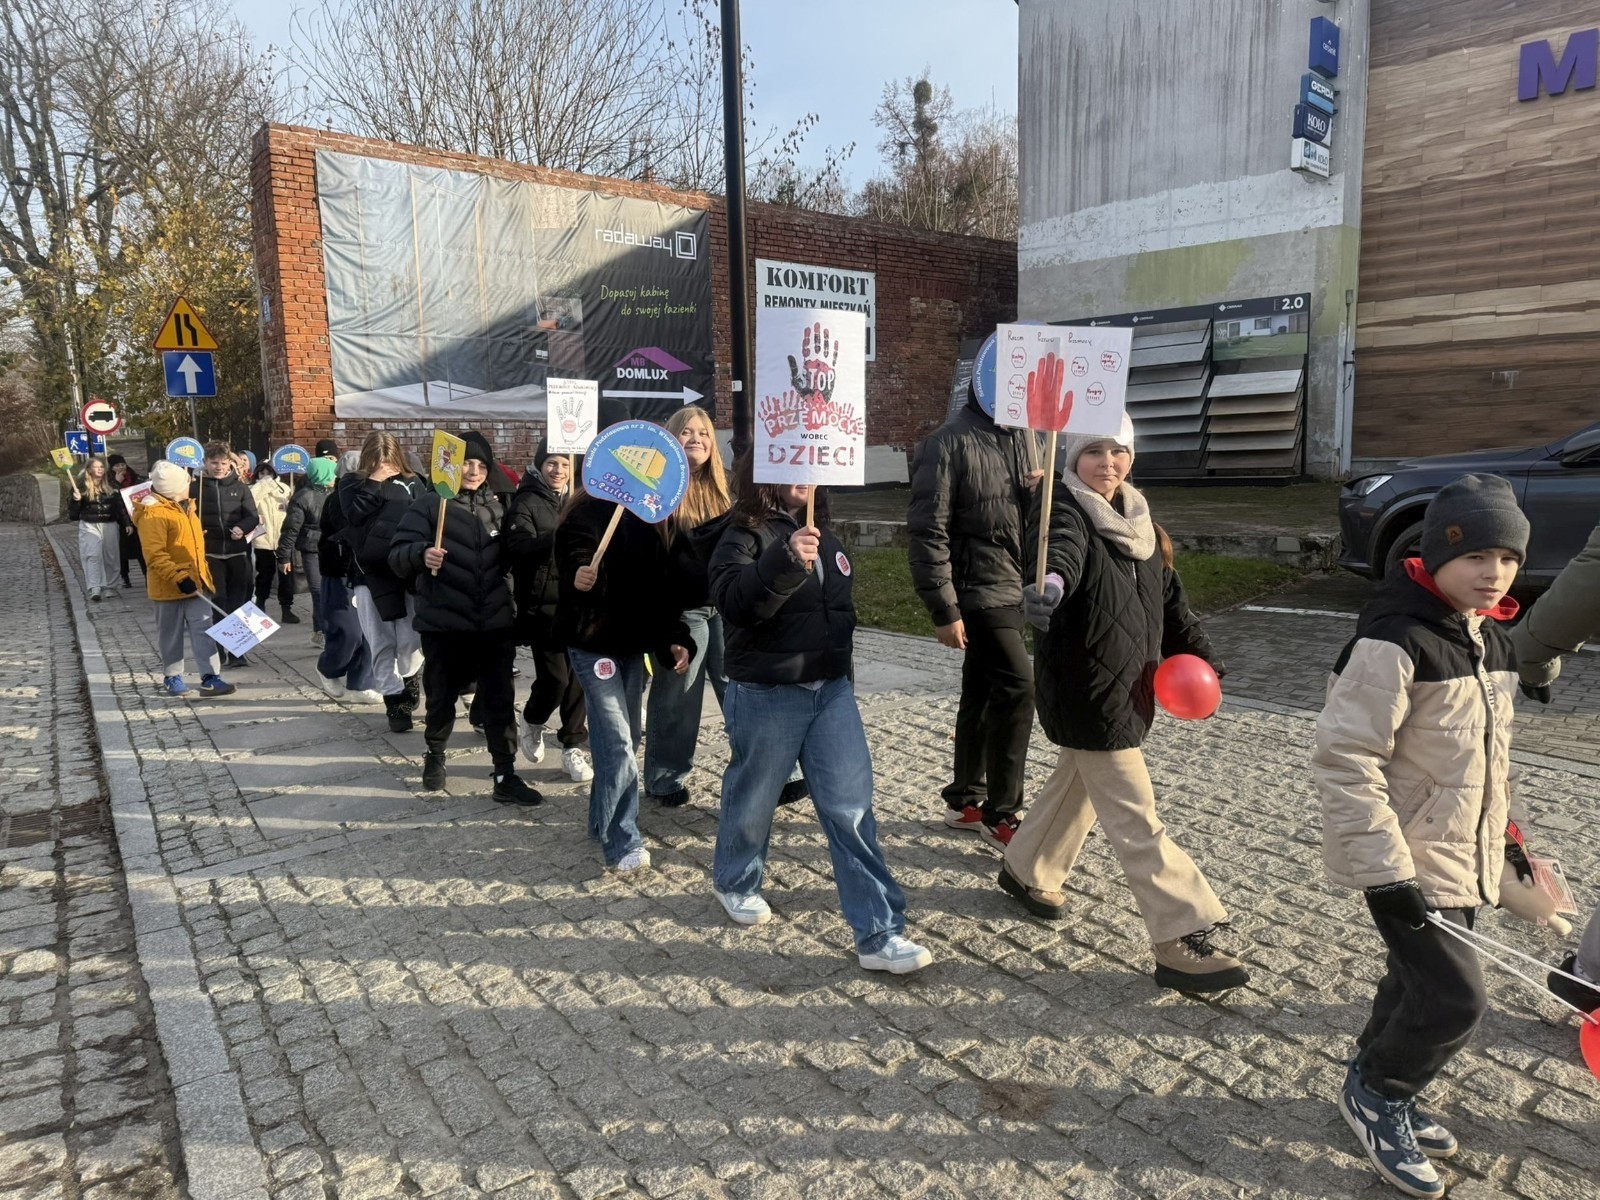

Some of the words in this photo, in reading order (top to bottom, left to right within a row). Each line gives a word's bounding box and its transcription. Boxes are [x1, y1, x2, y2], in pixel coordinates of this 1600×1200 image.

[1311, 80, 1334, 100] GERDA
[595, 223, 673, 257] radaway
[766, 266, 869, 296] KOMFORT
[600, 285, 637, 301] Dopasuj
[640, 285, 670, 300] kabinę
[620, 304, 632, 316] do
[635, 303, 661, 319] swojej
[664, 301, 697, 315] łazienki
[1281, 296, 1304, 310] 2.0
[630, 357, 646, 367] MB
[616, 367, 669, 380] DOMLUX
[796, 368, 835, 392] STOP
[595, 424, 630, 447] Podstawowa
[647, 426, 657, 434] im.
[800, 433, 828, 441] WOBEC
[768, 444, 855, 466] DZIECI
